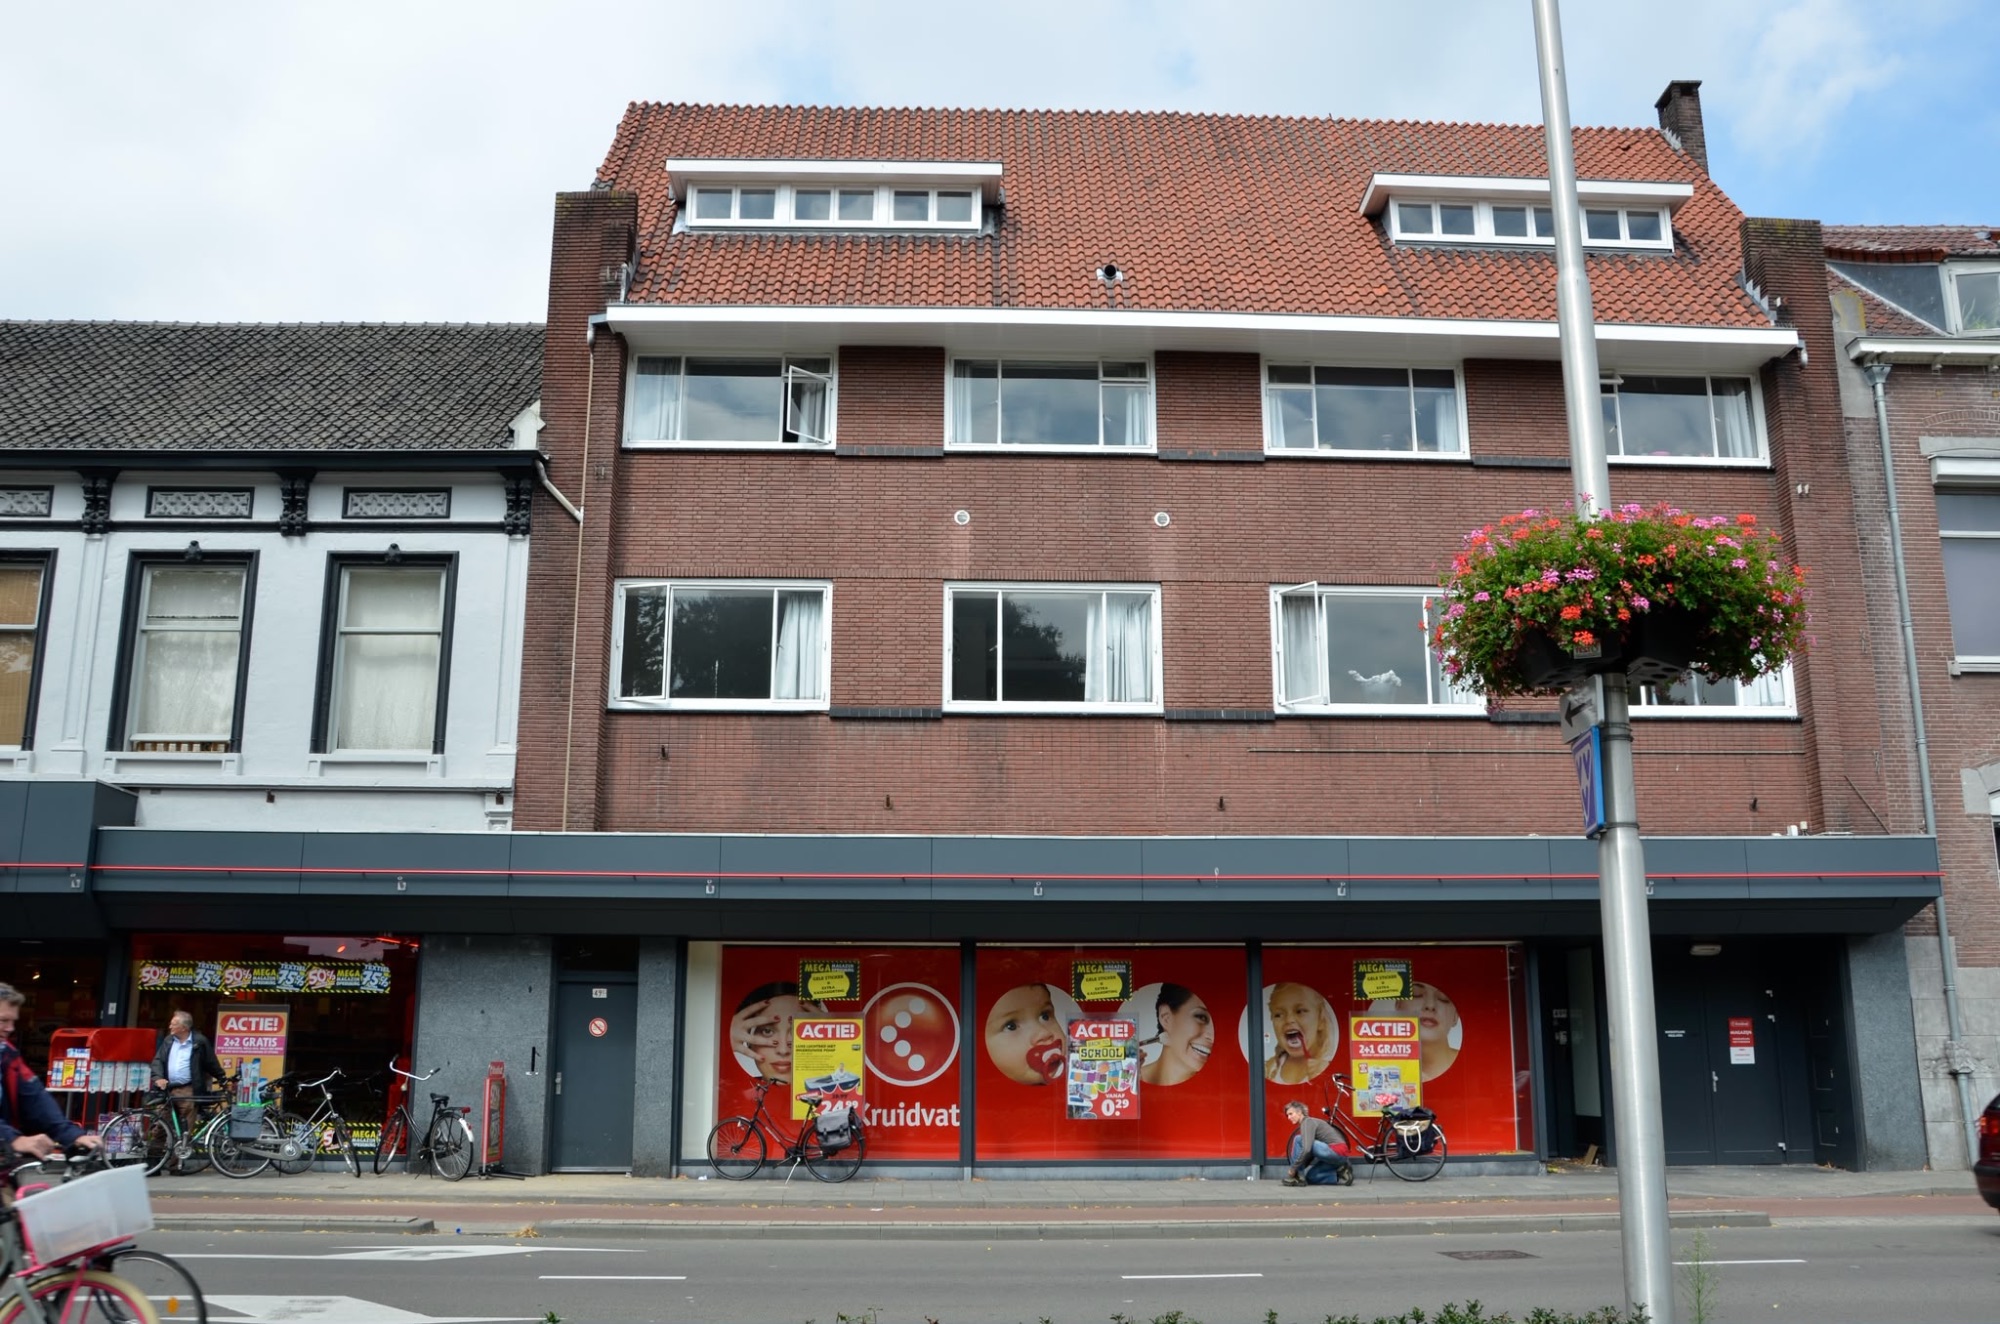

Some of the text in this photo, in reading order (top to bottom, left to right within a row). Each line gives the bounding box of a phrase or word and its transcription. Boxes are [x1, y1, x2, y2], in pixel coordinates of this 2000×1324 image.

[141, 966, 169, 983] 50%
[170, 967, 193, 975] MEGA
[805, 964, 831, 972] MEGA
[1077, 965, 1103, 973] MEGA
[1359, 964, 1385, 972] MEGA
[194, 968, 221, 986] 75%
[224, 967, 252, 984] 50%
[278, 969, 305, 987] 75%
[308, 969, 336, 985] 50%
[362, 970, 389, 988] 75%
[225, 1017, 279, 1031] ACTIE!
[801, 1024, 855, 1038] ACTIE!
[1075, 1024, 1128, 1038] ACTIE!
[1359, 1022, 1411, 1036] ACTIE!
[223, 1038, 278, 1047] 2+2 GRATIS
[1359, 1044, 1411, 1054] 2+1 GRATIS
[1081, 1048, 1123, 1058] SCHOOL
[352, 1130, 376, 1138] MEGA
